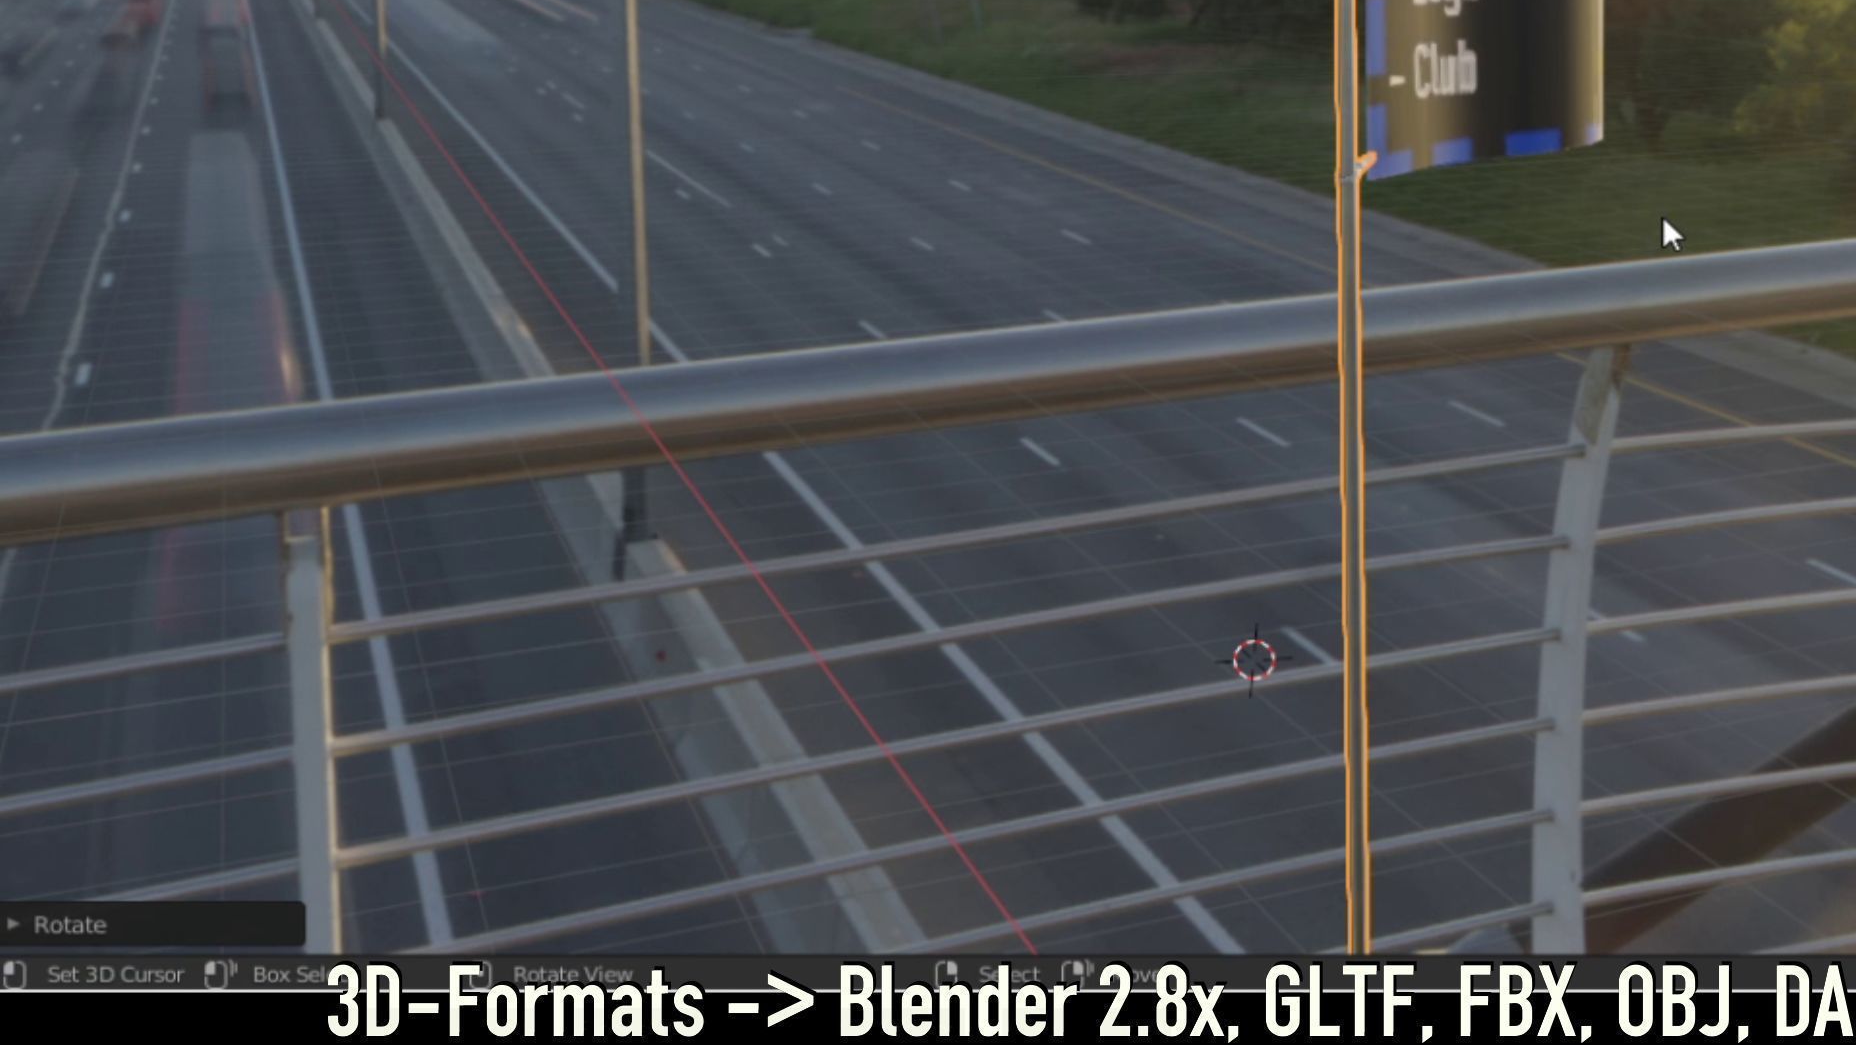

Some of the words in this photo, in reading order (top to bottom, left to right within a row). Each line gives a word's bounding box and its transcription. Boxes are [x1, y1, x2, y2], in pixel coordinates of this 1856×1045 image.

[1414, 39, 1478, 99] Club
[34, 916, 108, 934] Rotate
[48, 966, 79, 983] Set
[85, 966, 115, 983] 3D
[121, 966, 185, 983] Cursor
[253, 966, 291, 983] Box
[297, 966, 350, 983] Sel
[514, 966, 579, 983] Rotate
[584, 966, 633, 983] View
[979, 965, 1041, 983] Seect
